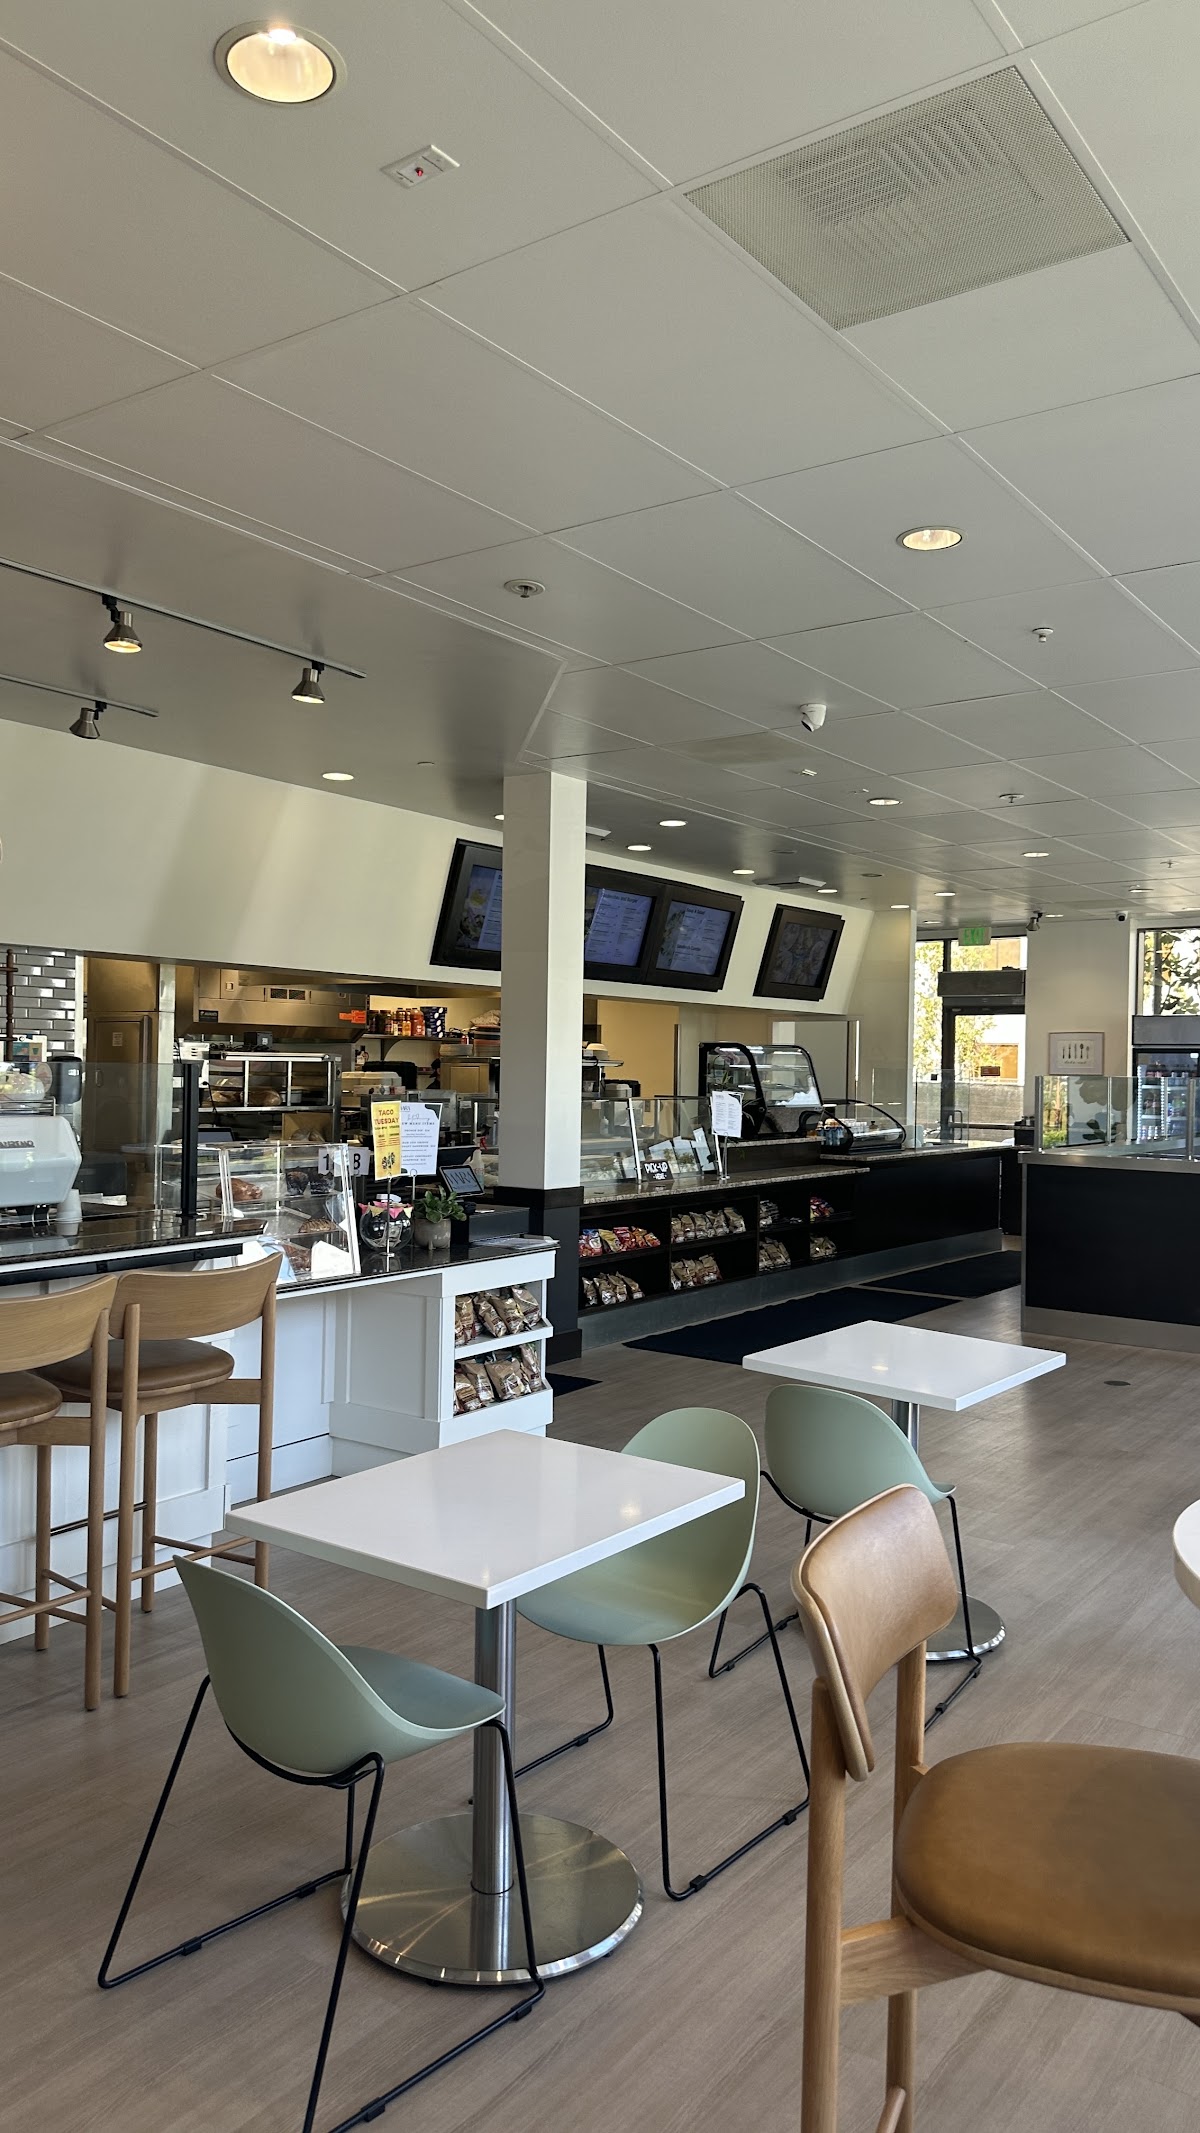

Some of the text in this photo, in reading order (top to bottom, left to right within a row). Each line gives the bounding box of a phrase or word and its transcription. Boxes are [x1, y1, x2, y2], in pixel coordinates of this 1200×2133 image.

[965, 927, 985, 944] EXIT
[374, 1117, 399, 1125] TUESDAY
[644, 1162, 668, 1174] PICK-UP
